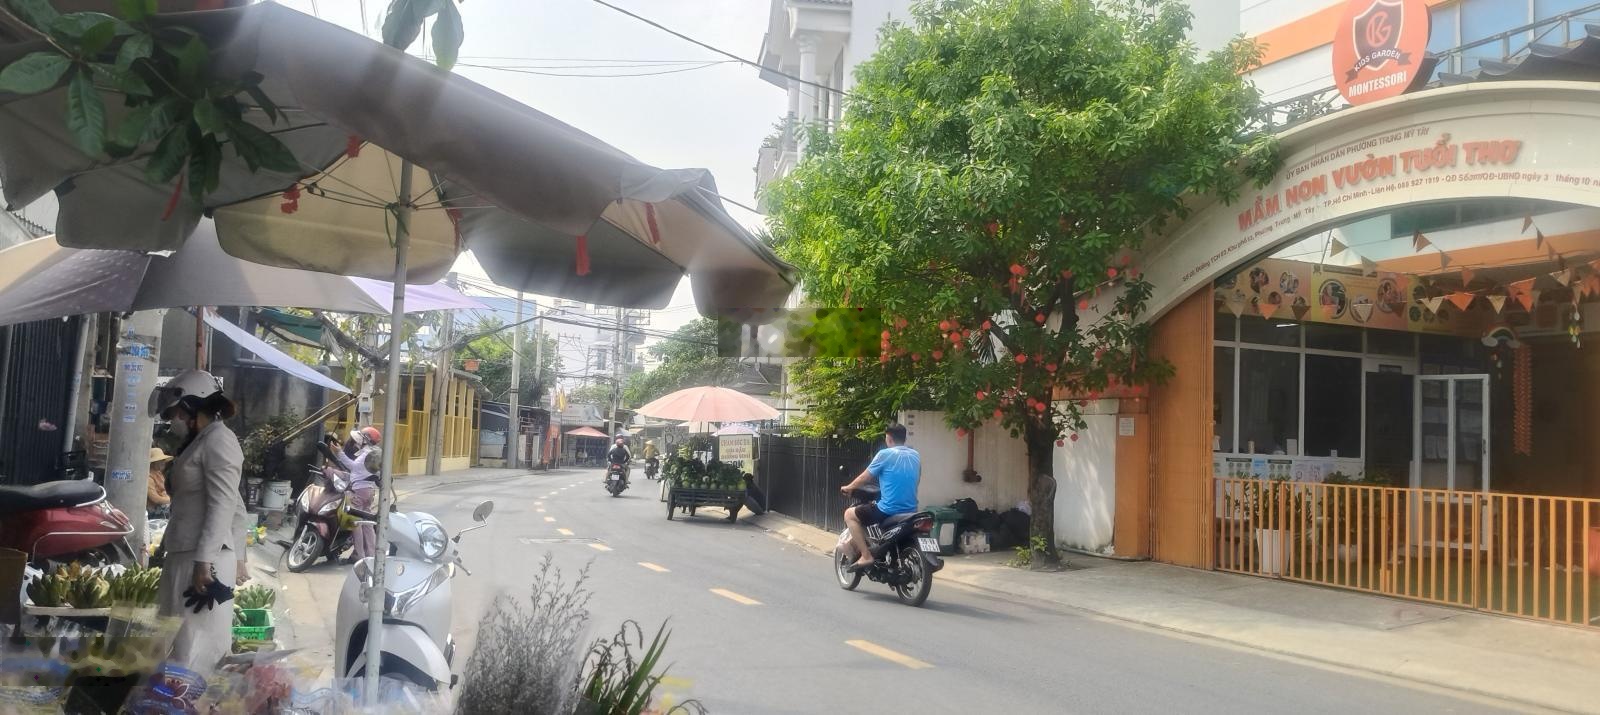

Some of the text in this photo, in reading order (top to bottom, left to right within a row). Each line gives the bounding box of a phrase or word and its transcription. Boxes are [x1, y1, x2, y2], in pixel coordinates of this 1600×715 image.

[1354, 49, 1401, 72] KIDS GARDEN
[1348, 71, 1407, 97] MONTESSORI
[1295, 164, 1310, 176] BAN
[1330, 148, 1346, 161] DÂN
[1237, 132, 1523, 231] MẦM NON VƯỜN TUỔI THƠ
[1275, 217, 1291, 228] Trung
[1555, 173, 1580, 186] tháng
